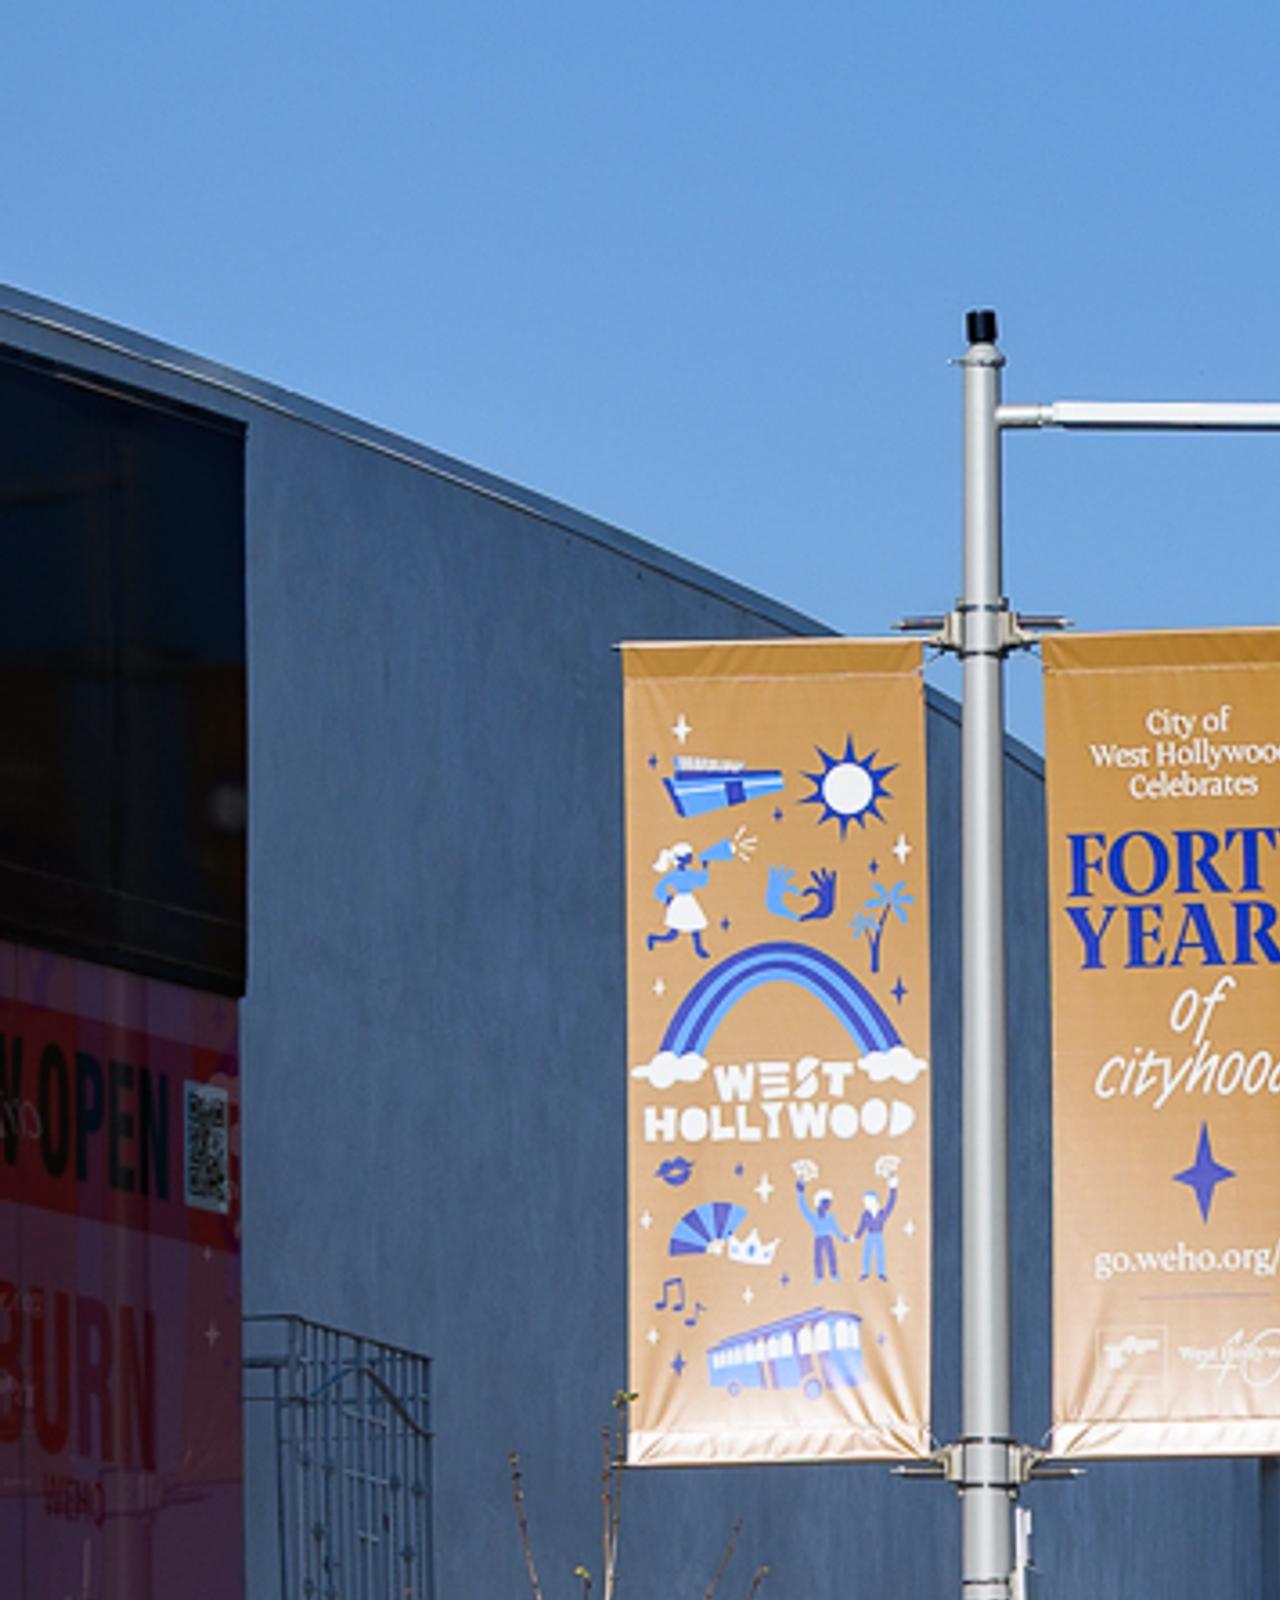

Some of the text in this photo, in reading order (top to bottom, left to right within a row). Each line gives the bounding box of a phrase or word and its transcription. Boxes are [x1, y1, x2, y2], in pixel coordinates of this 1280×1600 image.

[1146, 705, 1232, 740] City of
[1089, 744, 1151, 768] West
[1129, 771, 1260, 800] Celebrates
[1170, 975, 1236, 1046] of
[714, 1057, 854, 1101] WEST
[39, 1041, 170, 1201] OPEN
[644, 1098, 916, 1142] HOLLYWOOD
